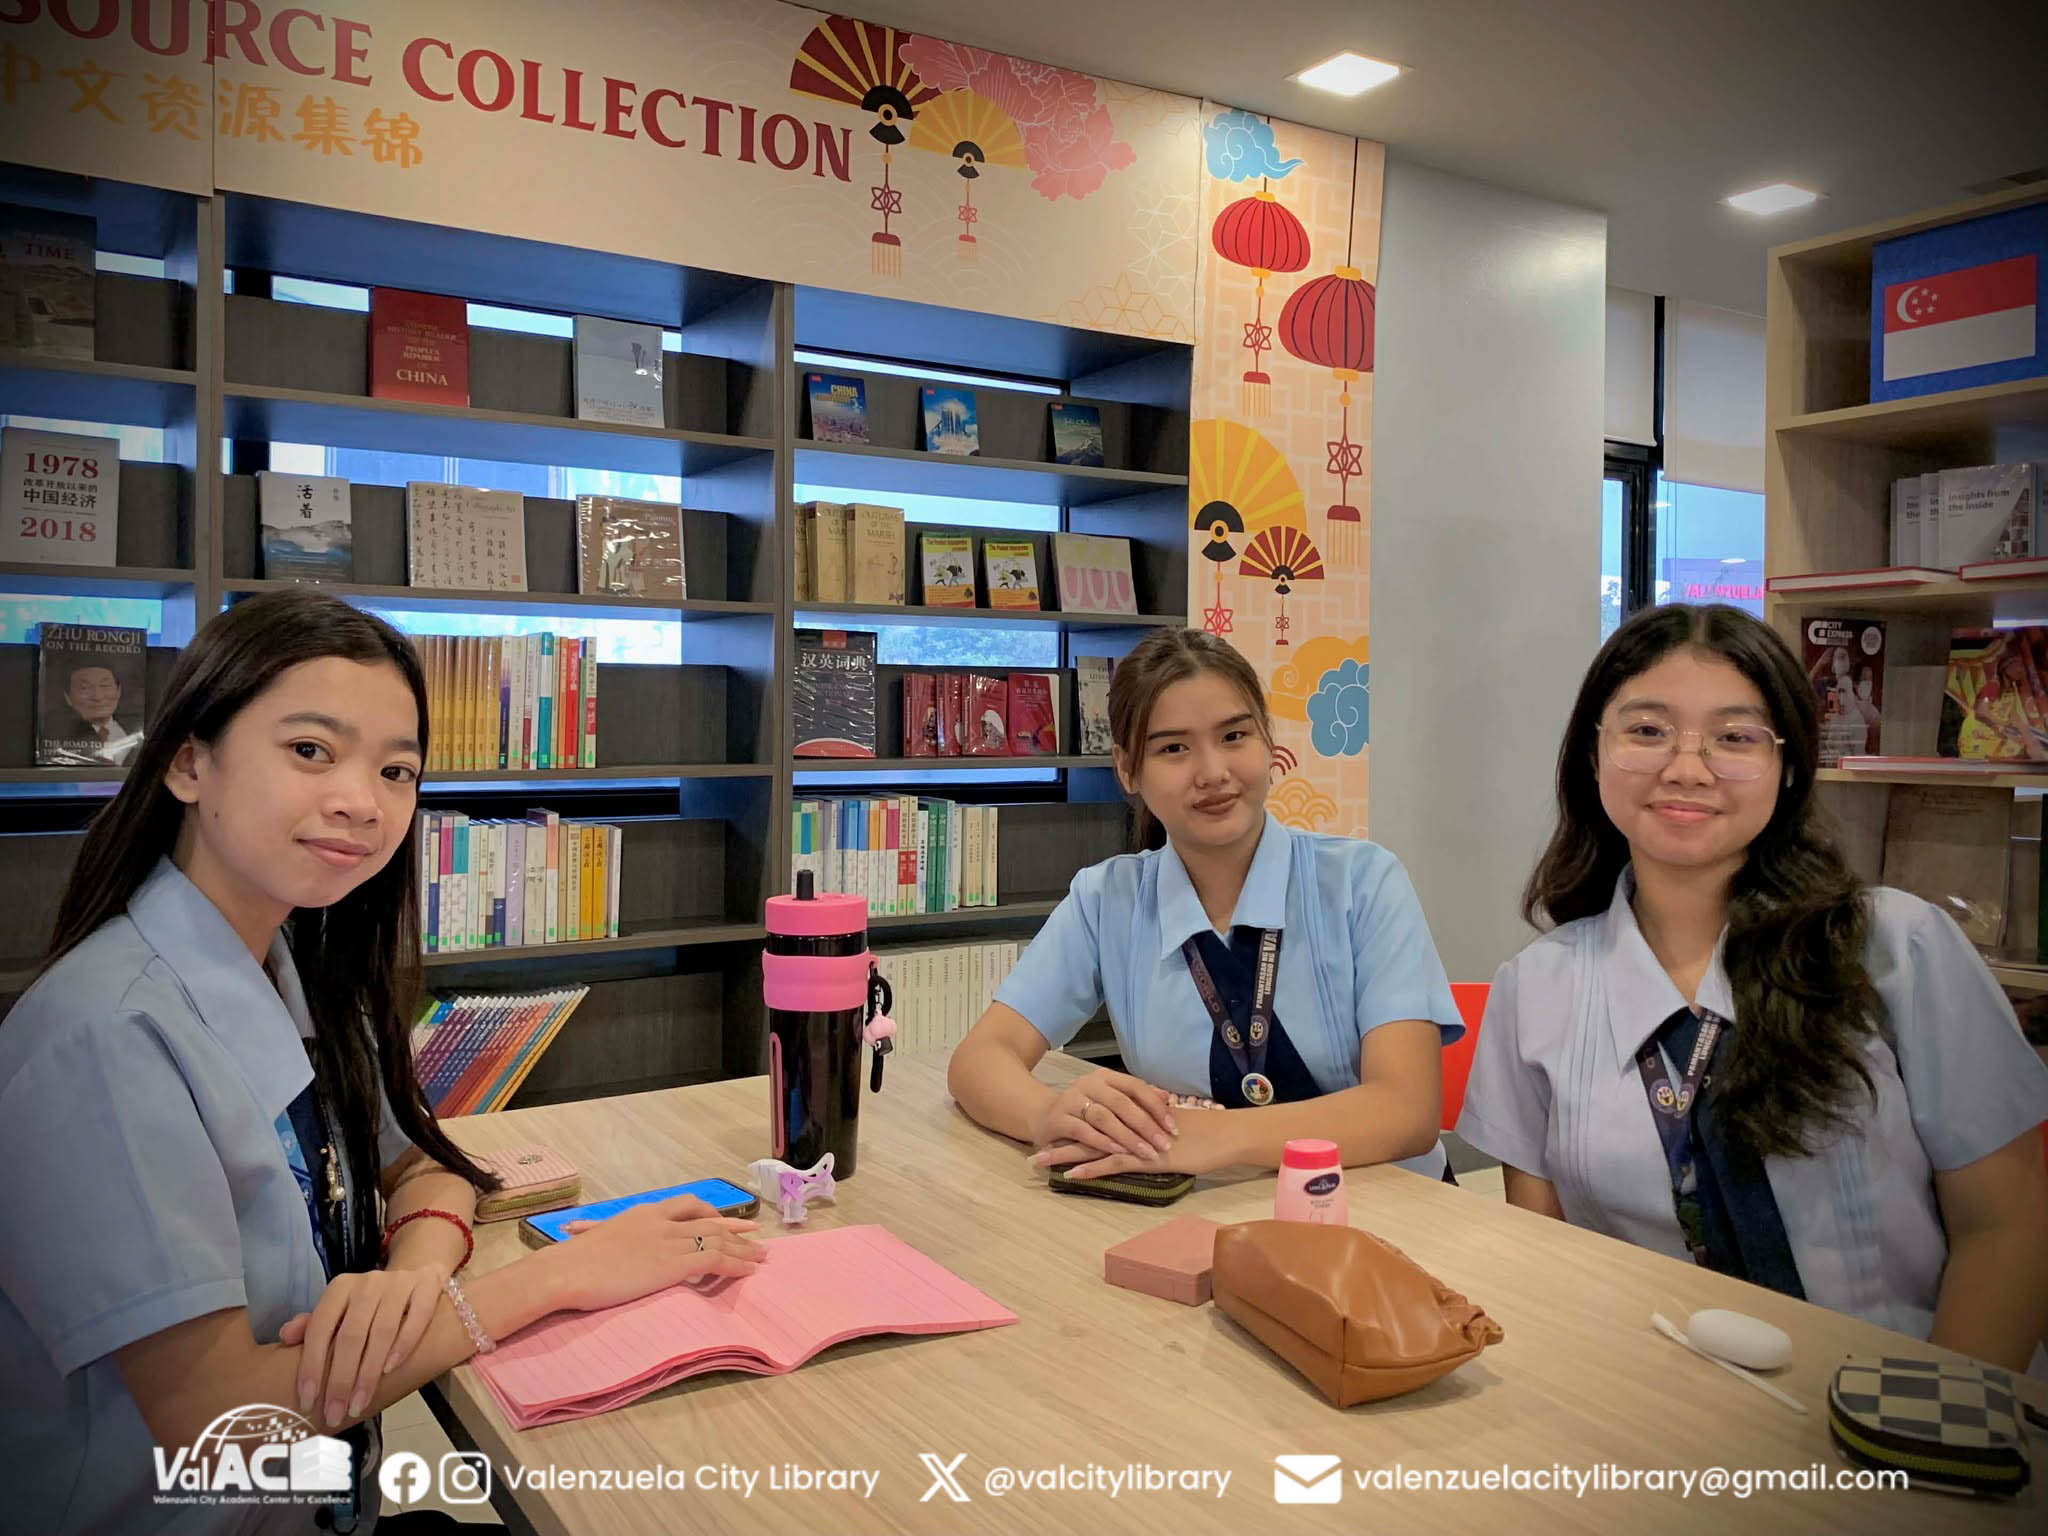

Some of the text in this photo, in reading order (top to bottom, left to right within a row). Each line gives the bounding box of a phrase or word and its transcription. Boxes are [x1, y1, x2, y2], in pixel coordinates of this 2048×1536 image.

[401, 37, 852, 183] COLLECTION
[396, 368, 449, 386] CHINA
[830, 384, 858, 398] CHINA
[24, 452, 99, 479] 1978
[23, 477, 99, 493] 改革开放以来的
[23, 488, 97, 509] 中国经济
[20, 516, 97, 543] 2018
[1826, 621, 1843, 630] CITY
[47, 627, 141, 646] ZHU RONGJI
[46, 640, 65, 650] ON
[95, 644, 142, 655] RECORD
[800, 651, 869, 672] 汉英词典
